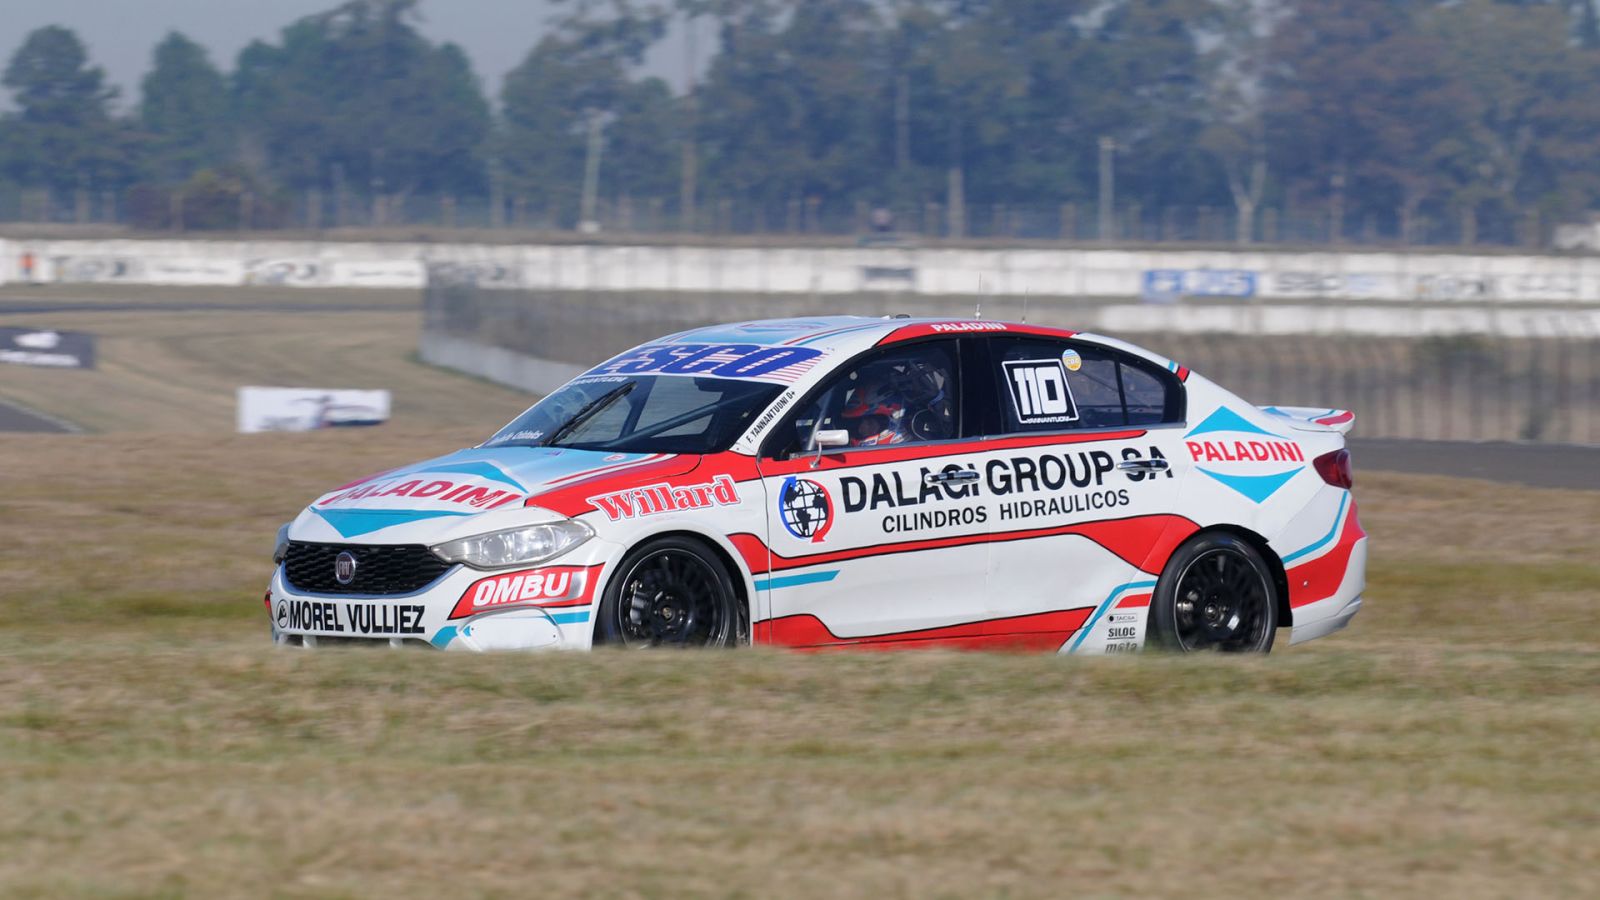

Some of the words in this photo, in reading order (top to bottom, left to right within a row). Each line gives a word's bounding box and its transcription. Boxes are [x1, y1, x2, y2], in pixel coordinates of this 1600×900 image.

[931, 321, 1007, 332] PALADINI
[1013, 366, 1067, 415] 110
[750, 396, 789, 438] YANNANTUONI
[1185, 441, 1305, 462] PALADINI
[986, 450, 1114, 496] GROUP
[319, 480, 523, 510] PALADINI
[587, 475, 740, 521] Willard
[882, 505, 988, 534] CILINDROS
[1000, 489, 1130, 520] HIDRAULICOS
[472, 572, 568, 607] OMBU
[289, 600, 344, 632] MOREL
[346, 603, 426, 634] VULLIEZ
[1108, 626, 1136, 637] SILOC
